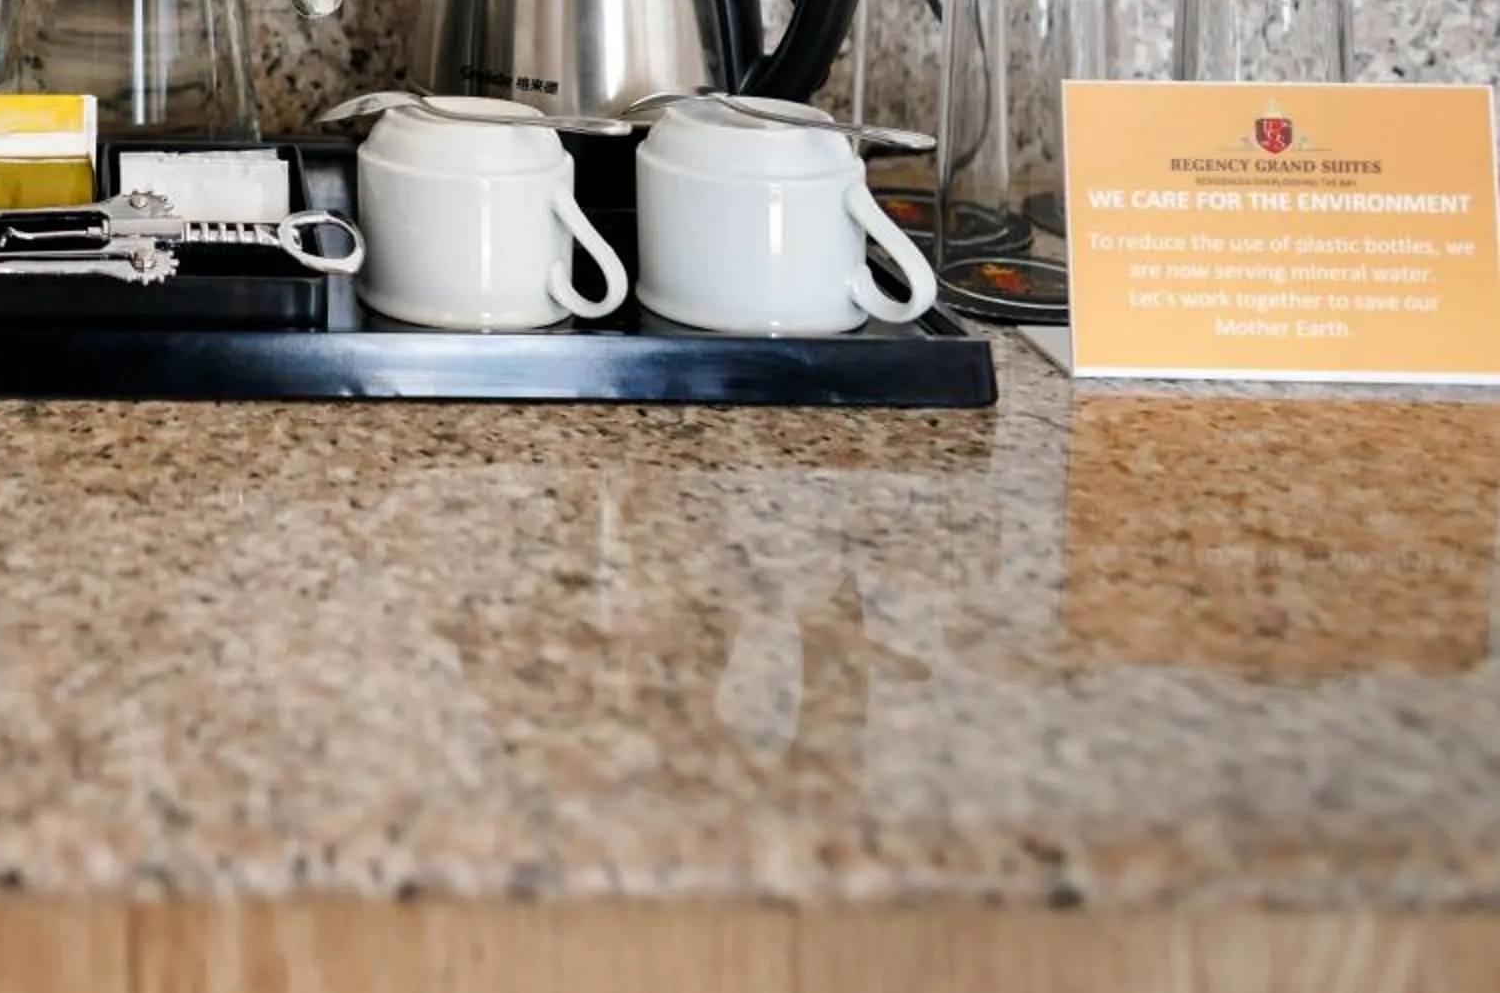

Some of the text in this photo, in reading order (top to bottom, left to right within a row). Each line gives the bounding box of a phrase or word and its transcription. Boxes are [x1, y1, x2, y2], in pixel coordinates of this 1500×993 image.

[1170, 158, 1382, 175] REGENCY GRAND SUITES
[1088, 189, 1472, 214] WE CARE FOR THE ENVIRONMENT
[1088, 231, 1476, 258] To reduce the use of plastic bottles, we
[1128, 261, 1437, 285] are now serving mineral water.
[1128, 290, 1438, 315] Let's work together to save our
[1214, 318, 1289, 337] Mother
